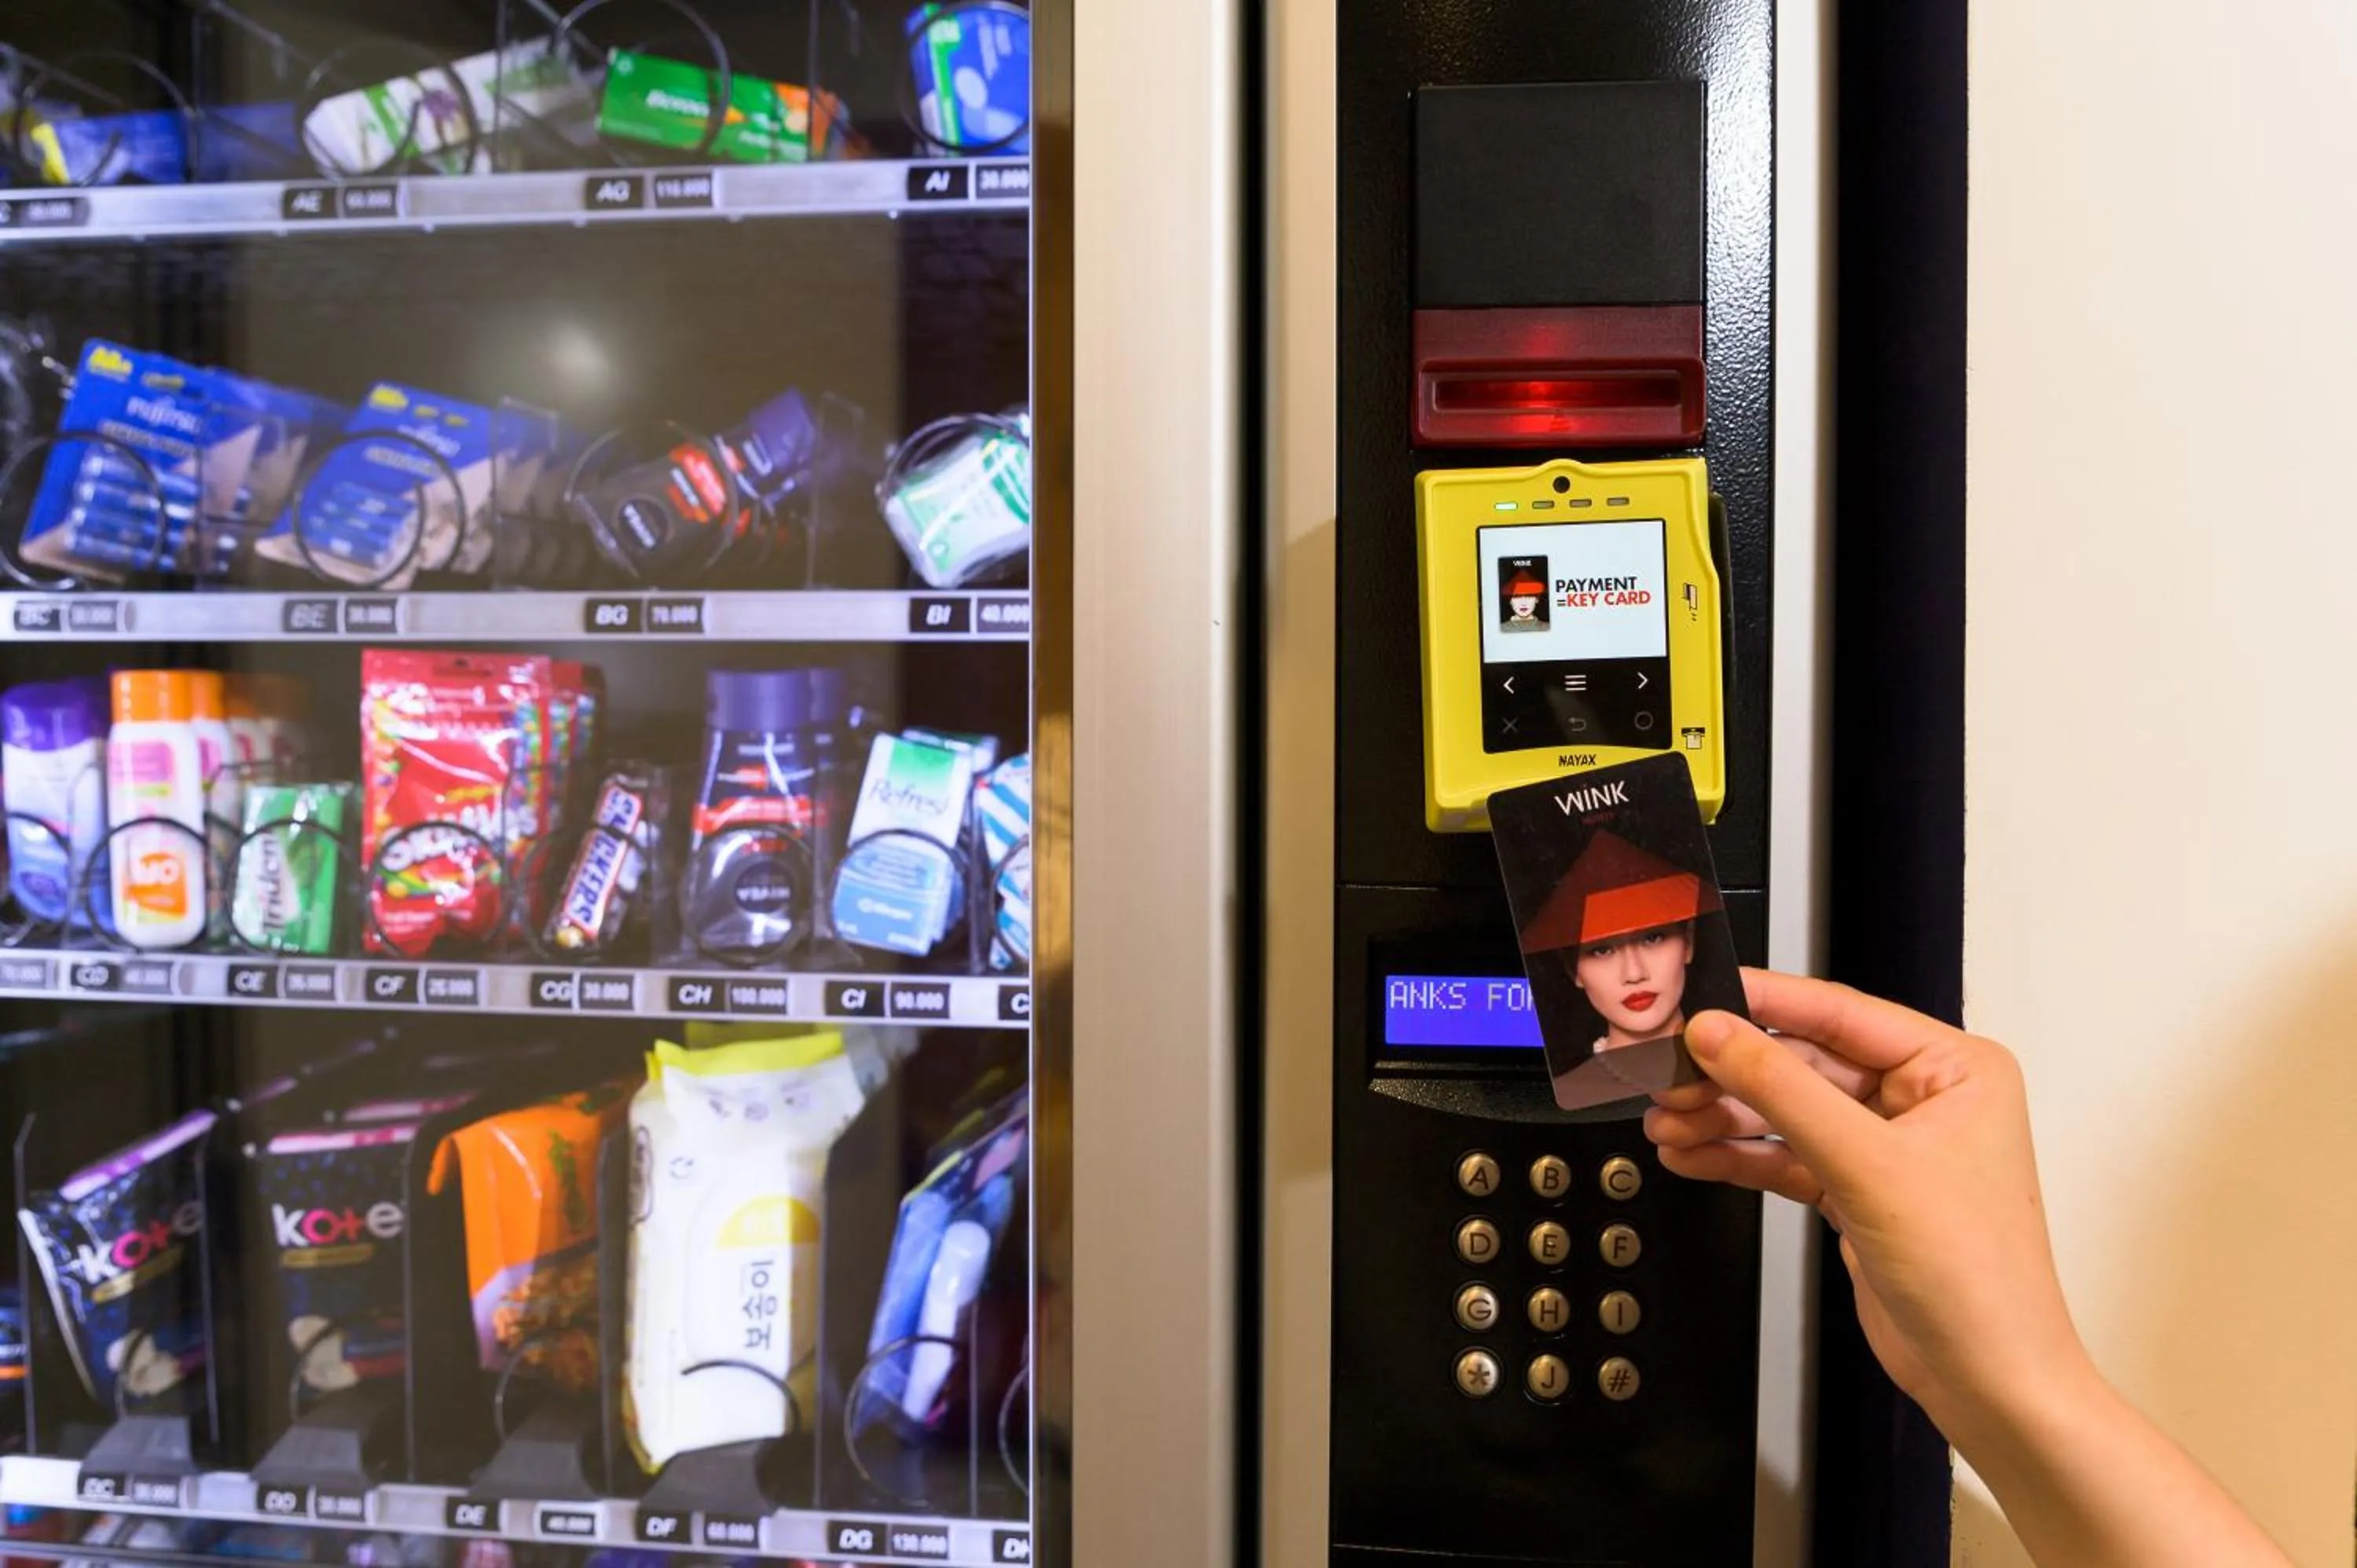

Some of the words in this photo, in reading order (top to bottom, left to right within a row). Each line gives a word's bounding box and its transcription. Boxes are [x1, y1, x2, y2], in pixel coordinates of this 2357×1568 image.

[595, 179, 630, 203] AG
[924, 170, 951, 192] AI
[1556, 577, 1637, 592] PAYMENT
[1604, 590, 1651, 606] CARD
[595, 603, 629, 626] BG
[926, 603, 952, 626] BI
[1558, 754, 1597, 767] NAYAX
[1554, 780, 1630, 816] WINK
[374, 975, 406, 997] CF
[678, 983, 713, 1006] CH
[1390, 981, 1467, 1009] ANKS
[841, 987, 867, 1009] CI
[1468, 1167, 1489, 1189] A
[1543, 1167, 1560, 1189] B
[1608, 1170, 1632, 1192] C
[1469, 1233, 1490, 1255] D
[1542, 1234, 1558, 1257] E
[1613, 1236, 1627, 1258] F
[1467, 1299, 1491, 1321] G
[1539, 1300, 1559, 1324] H
[1540, 1365, 1556, 1389] J
[1607, 1369, 1631, 1393] #
[455, 1504, 488, 1526] DE
[645, 1516, 677, 1537] DF
[838, 1528, 874, 1551] DG
